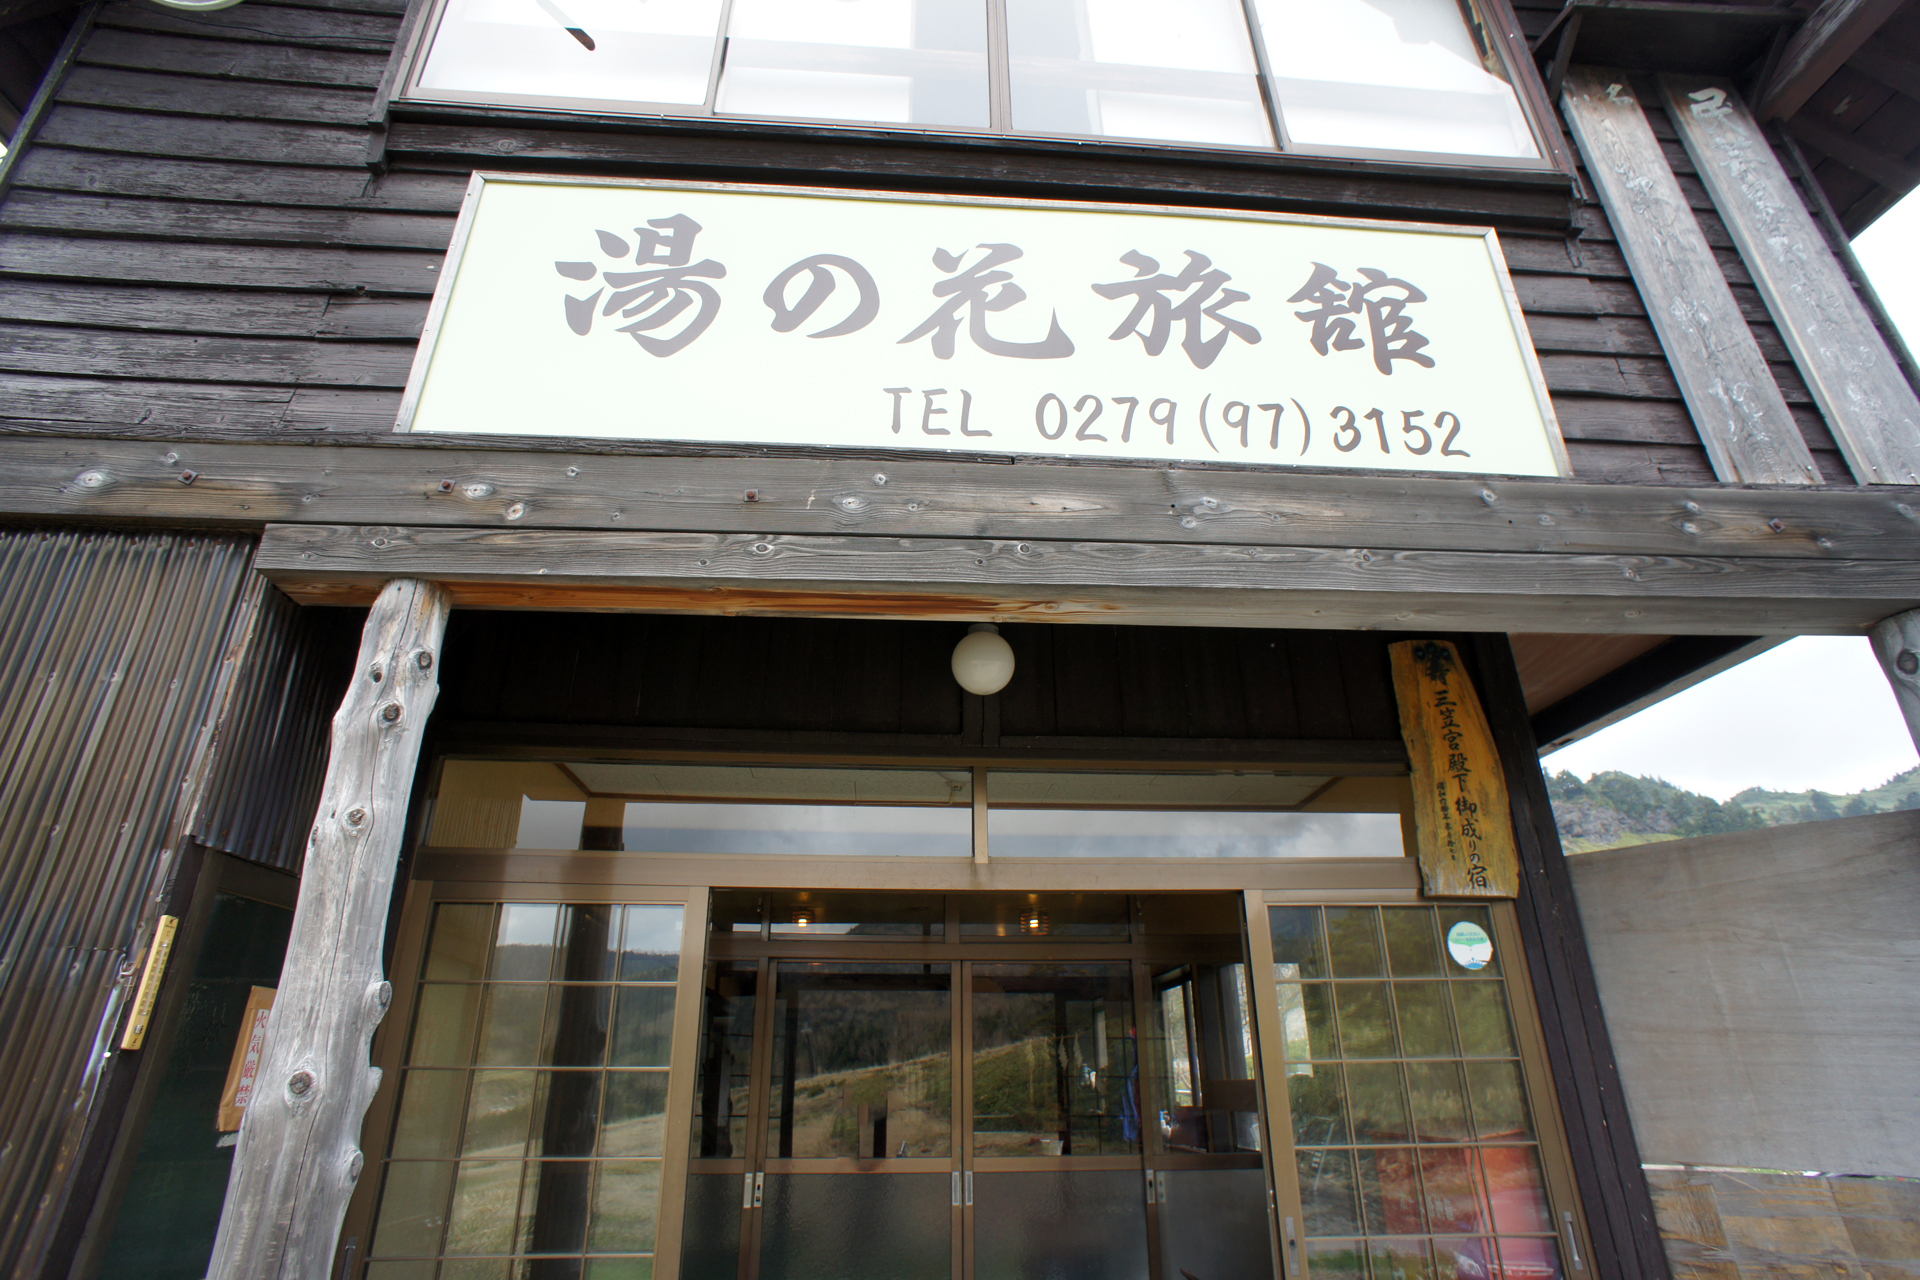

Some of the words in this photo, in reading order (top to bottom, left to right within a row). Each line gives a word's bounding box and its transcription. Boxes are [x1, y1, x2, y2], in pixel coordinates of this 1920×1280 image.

[884, 387, 992, 436] TEL
[1036, 393, 1471, 458] 0279(97)3152
[236, 1010, 267, 1104] 火気厳禁
